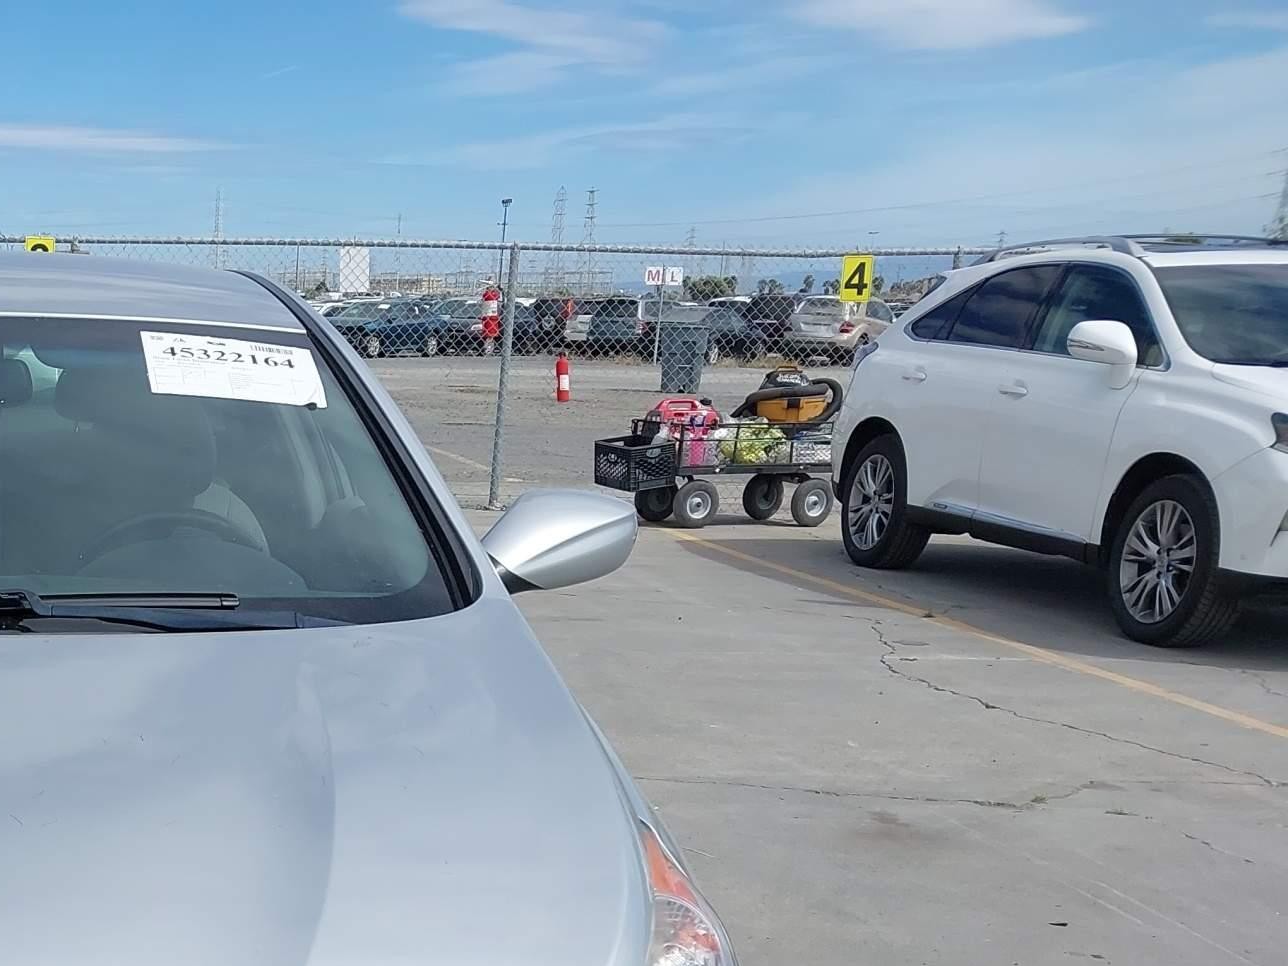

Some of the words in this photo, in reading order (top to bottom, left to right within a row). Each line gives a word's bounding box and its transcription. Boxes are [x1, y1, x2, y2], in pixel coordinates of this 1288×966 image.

[647, 269, 661, 282] M
[670, 270, 679, 282] L
[844, 262, 868, 296] 4
[162, 346, 295, 369] 45322164
